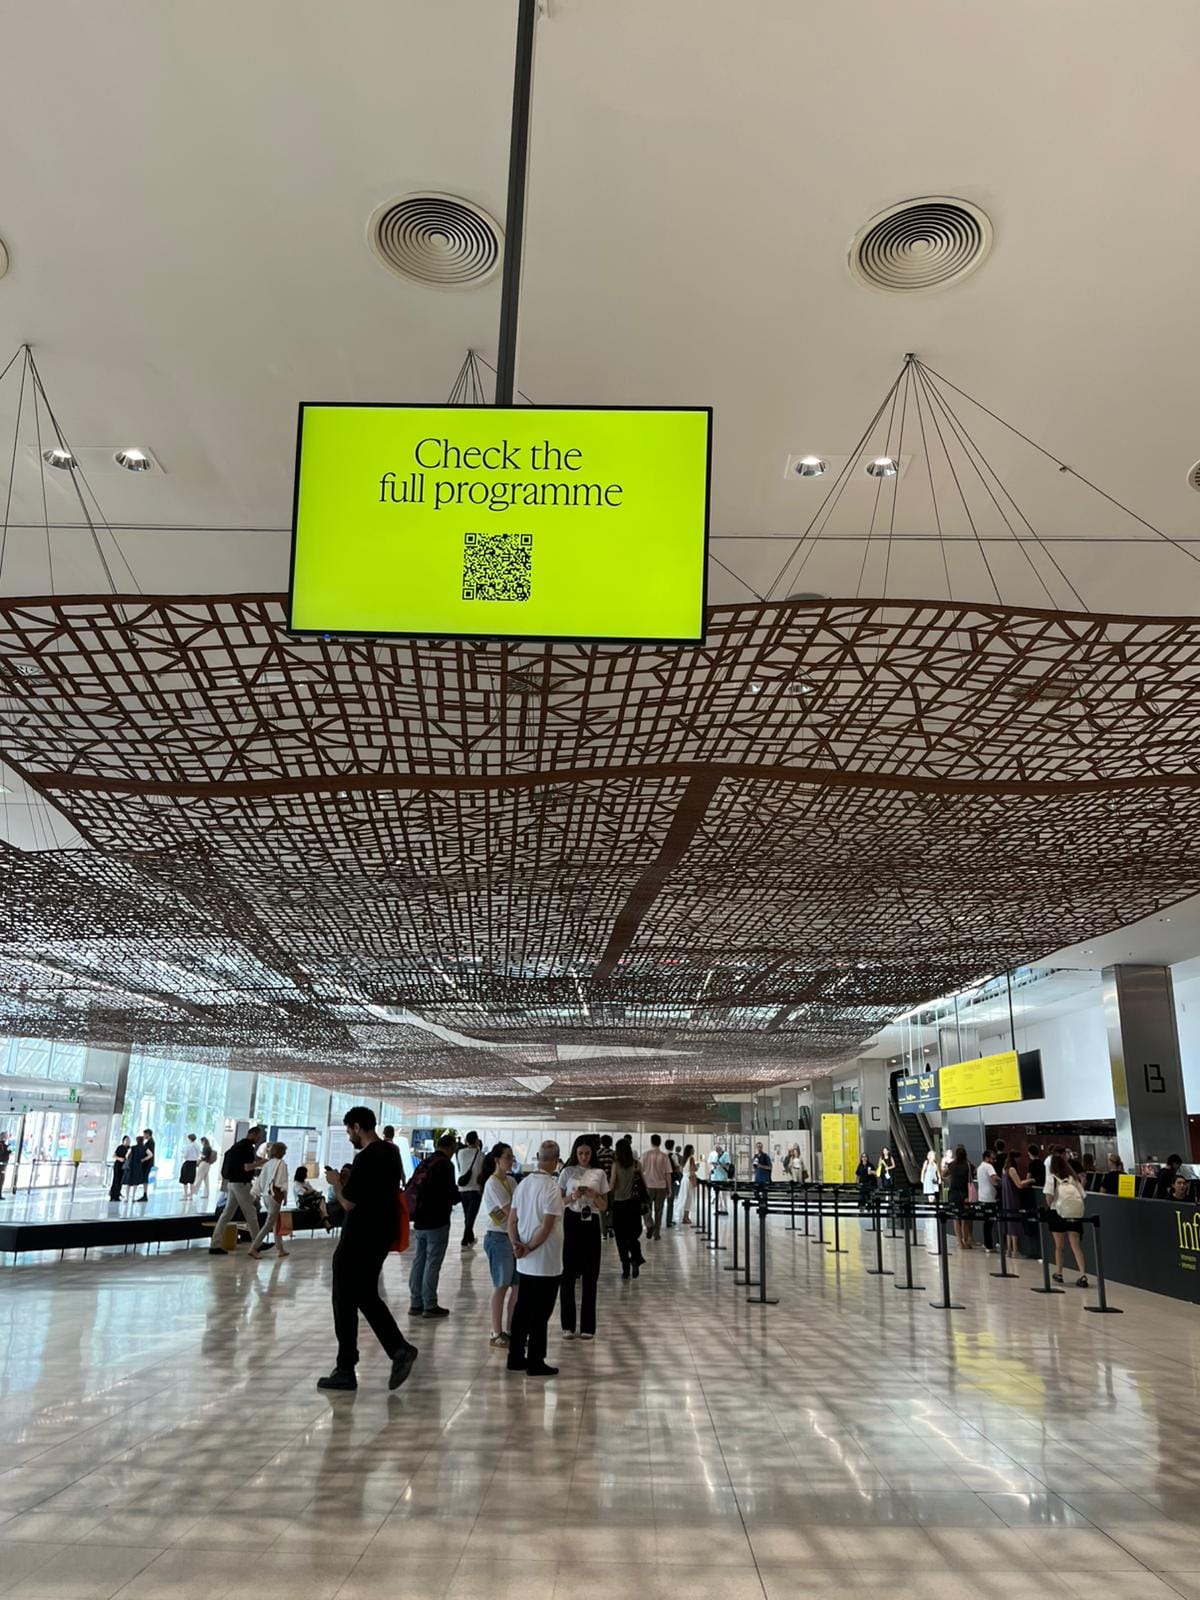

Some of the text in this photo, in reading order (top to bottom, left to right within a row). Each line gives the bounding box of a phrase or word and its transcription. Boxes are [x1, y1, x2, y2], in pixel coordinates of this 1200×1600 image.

[415, 438, 583, 471] Check the
[379, 472, 623, 512] full programme
[1143, 1064, 1166, 1093] B
[871, 1106, 881, 1121] C
[1175, 1210, 1200, 1252] Inf
